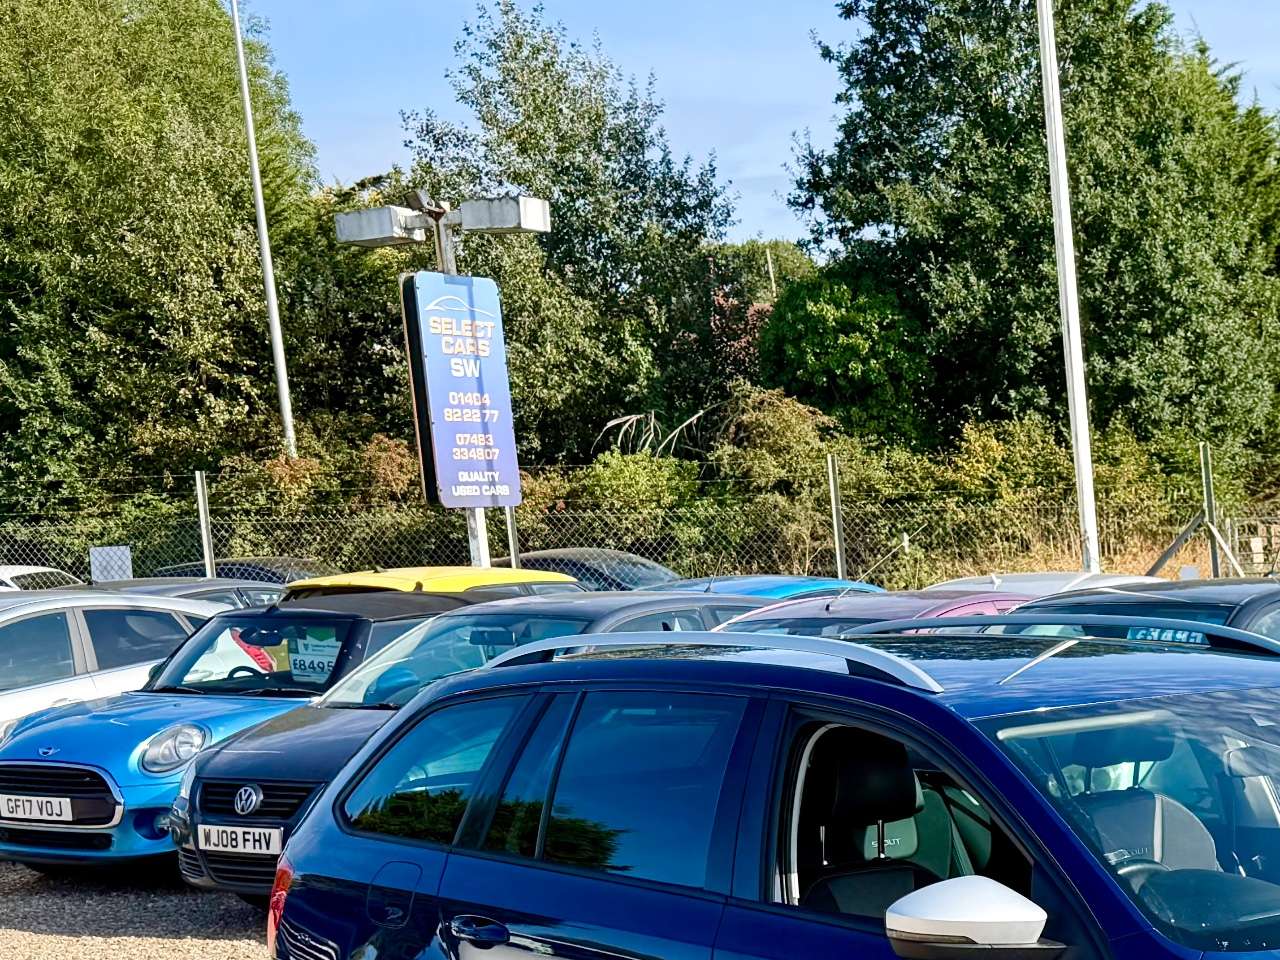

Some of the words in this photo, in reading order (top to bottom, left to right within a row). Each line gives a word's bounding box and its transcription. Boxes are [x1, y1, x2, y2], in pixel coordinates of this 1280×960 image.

[430, 316, 495, 338] SELECT
[442, 336, 490, 357] CARS
[450, 358, 480, 378] SW
[449, 391, 490, 406] 01404
[458, 471, 499, 482] QUALITY
[451, 485, 480, 496] USED
[482, 485, 510, 496] CARS
[293, 658, 334, 673] £8495
[6, 799, 33, 816] GF17
[37, 801, 62, 817] VOJ
[204, 828, 238, 849] WJ08
[243, 831, 272, 851] FHV
